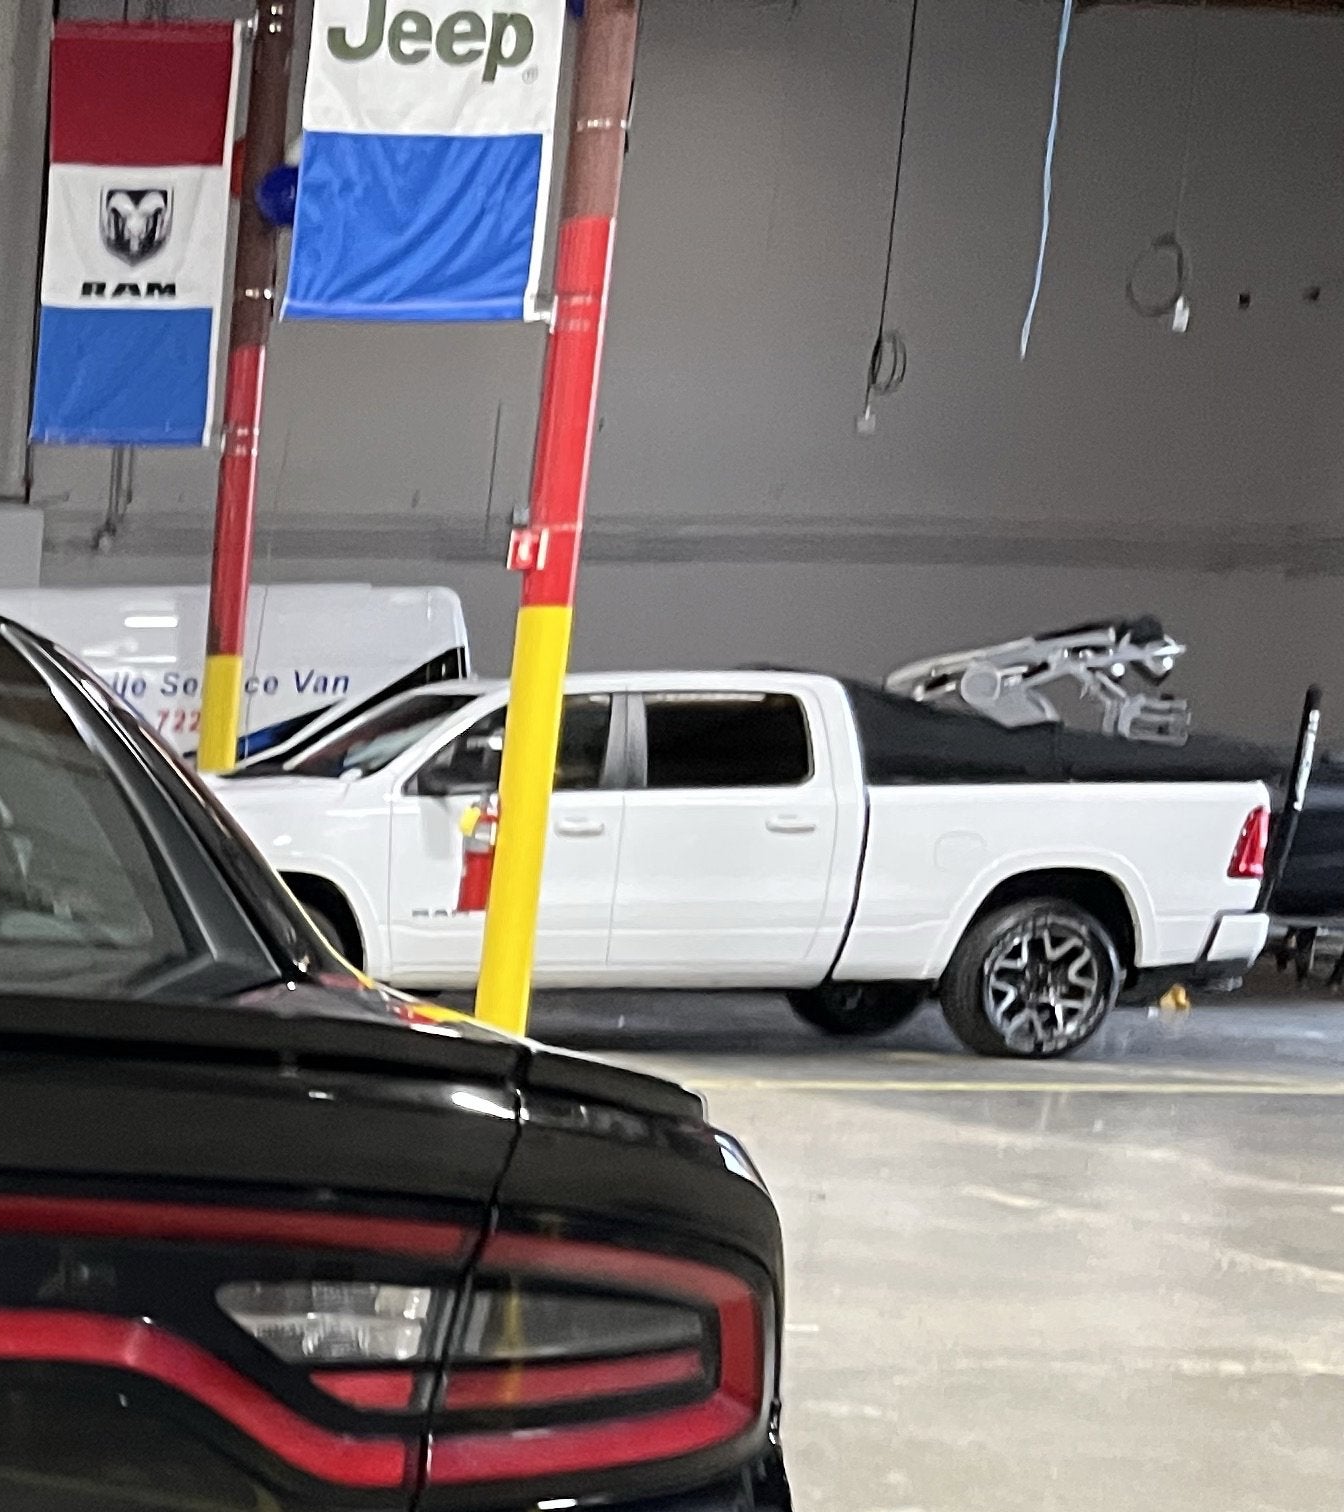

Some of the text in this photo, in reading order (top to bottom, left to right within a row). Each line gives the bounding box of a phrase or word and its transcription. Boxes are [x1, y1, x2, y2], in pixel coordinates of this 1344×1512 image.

[327, 0, 534, 83] Jeep
[80, 281, 176, 298] RAM
[293, 669, 350, 695] Van
